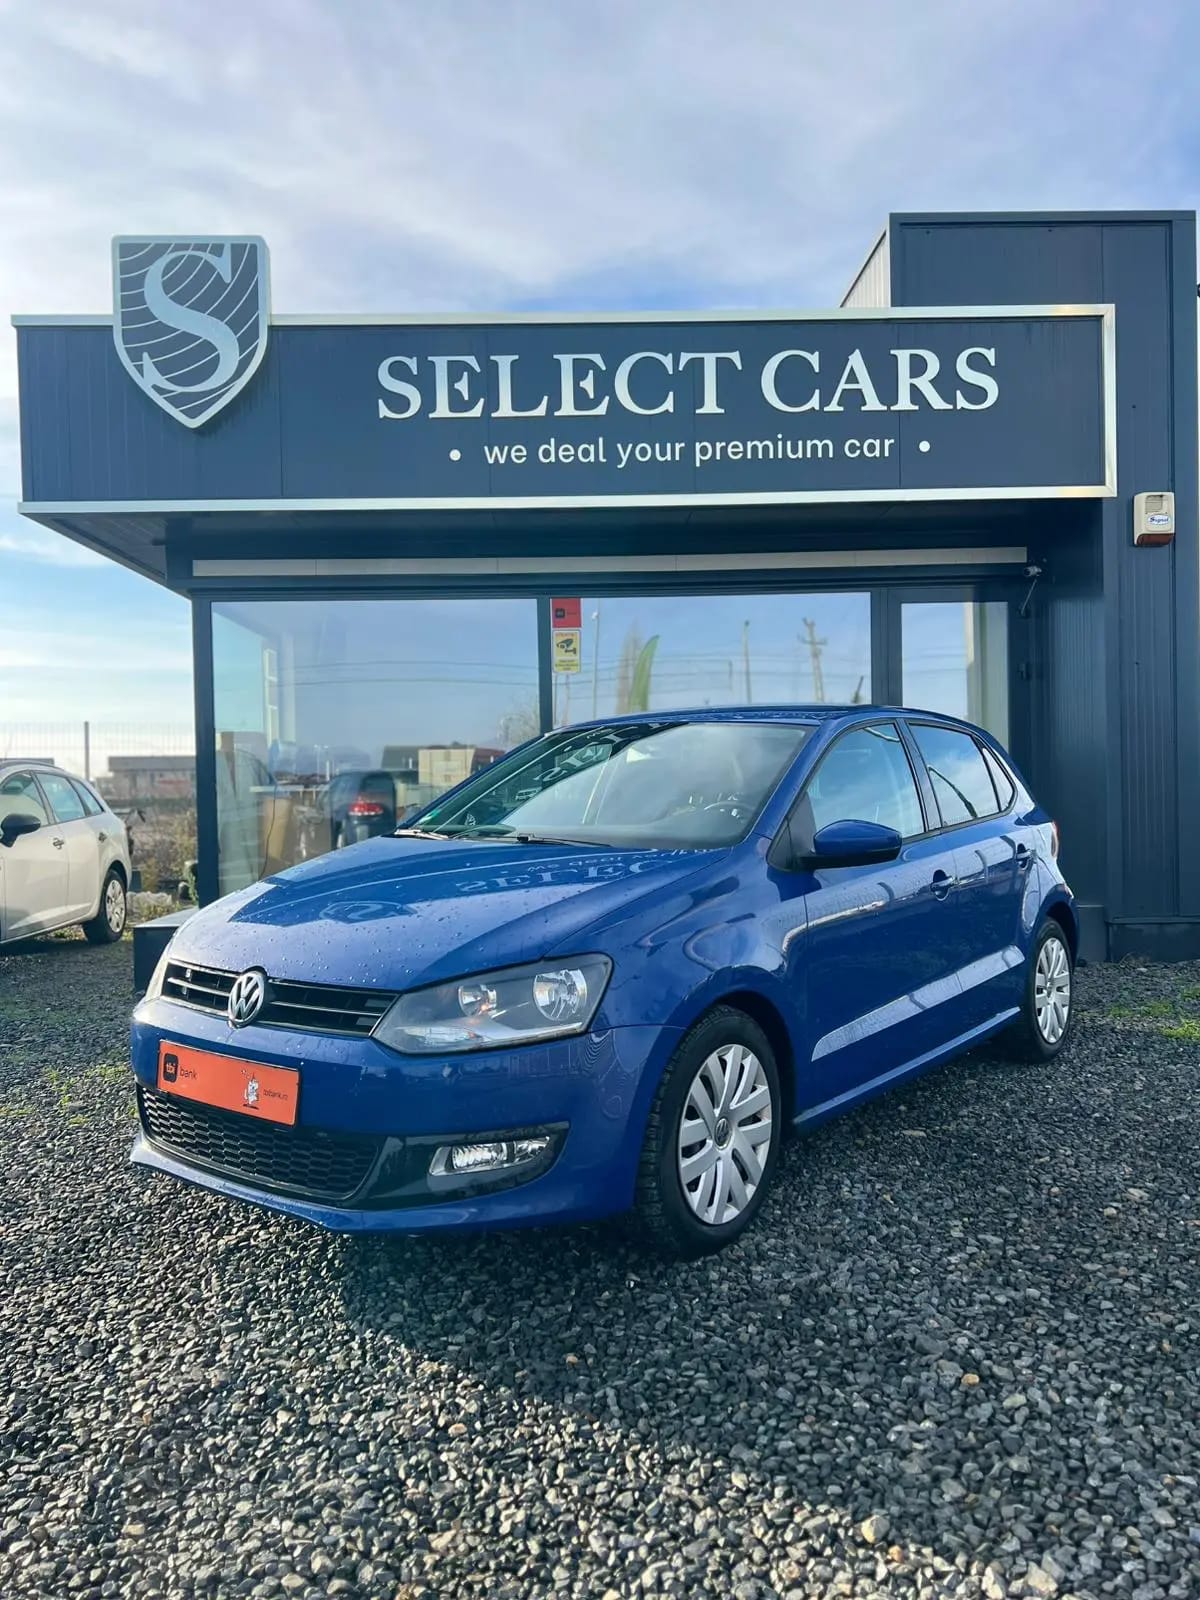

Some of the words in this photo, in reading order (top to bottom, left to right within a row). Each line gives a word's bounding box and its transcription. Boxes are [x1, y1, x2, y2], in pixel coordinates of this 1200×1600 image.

[377, 350, 742, 419] SELECT
[760, 347, 1000, 414] CARS
[484, 445, 528, 464] we
[538, 437, 607, 463] deal
[616, 442, 686, 469] your
[695, 433, 834, 467] premium
[844, 438, 895, 458] car
[180, 1065, 198, 1080] bank
